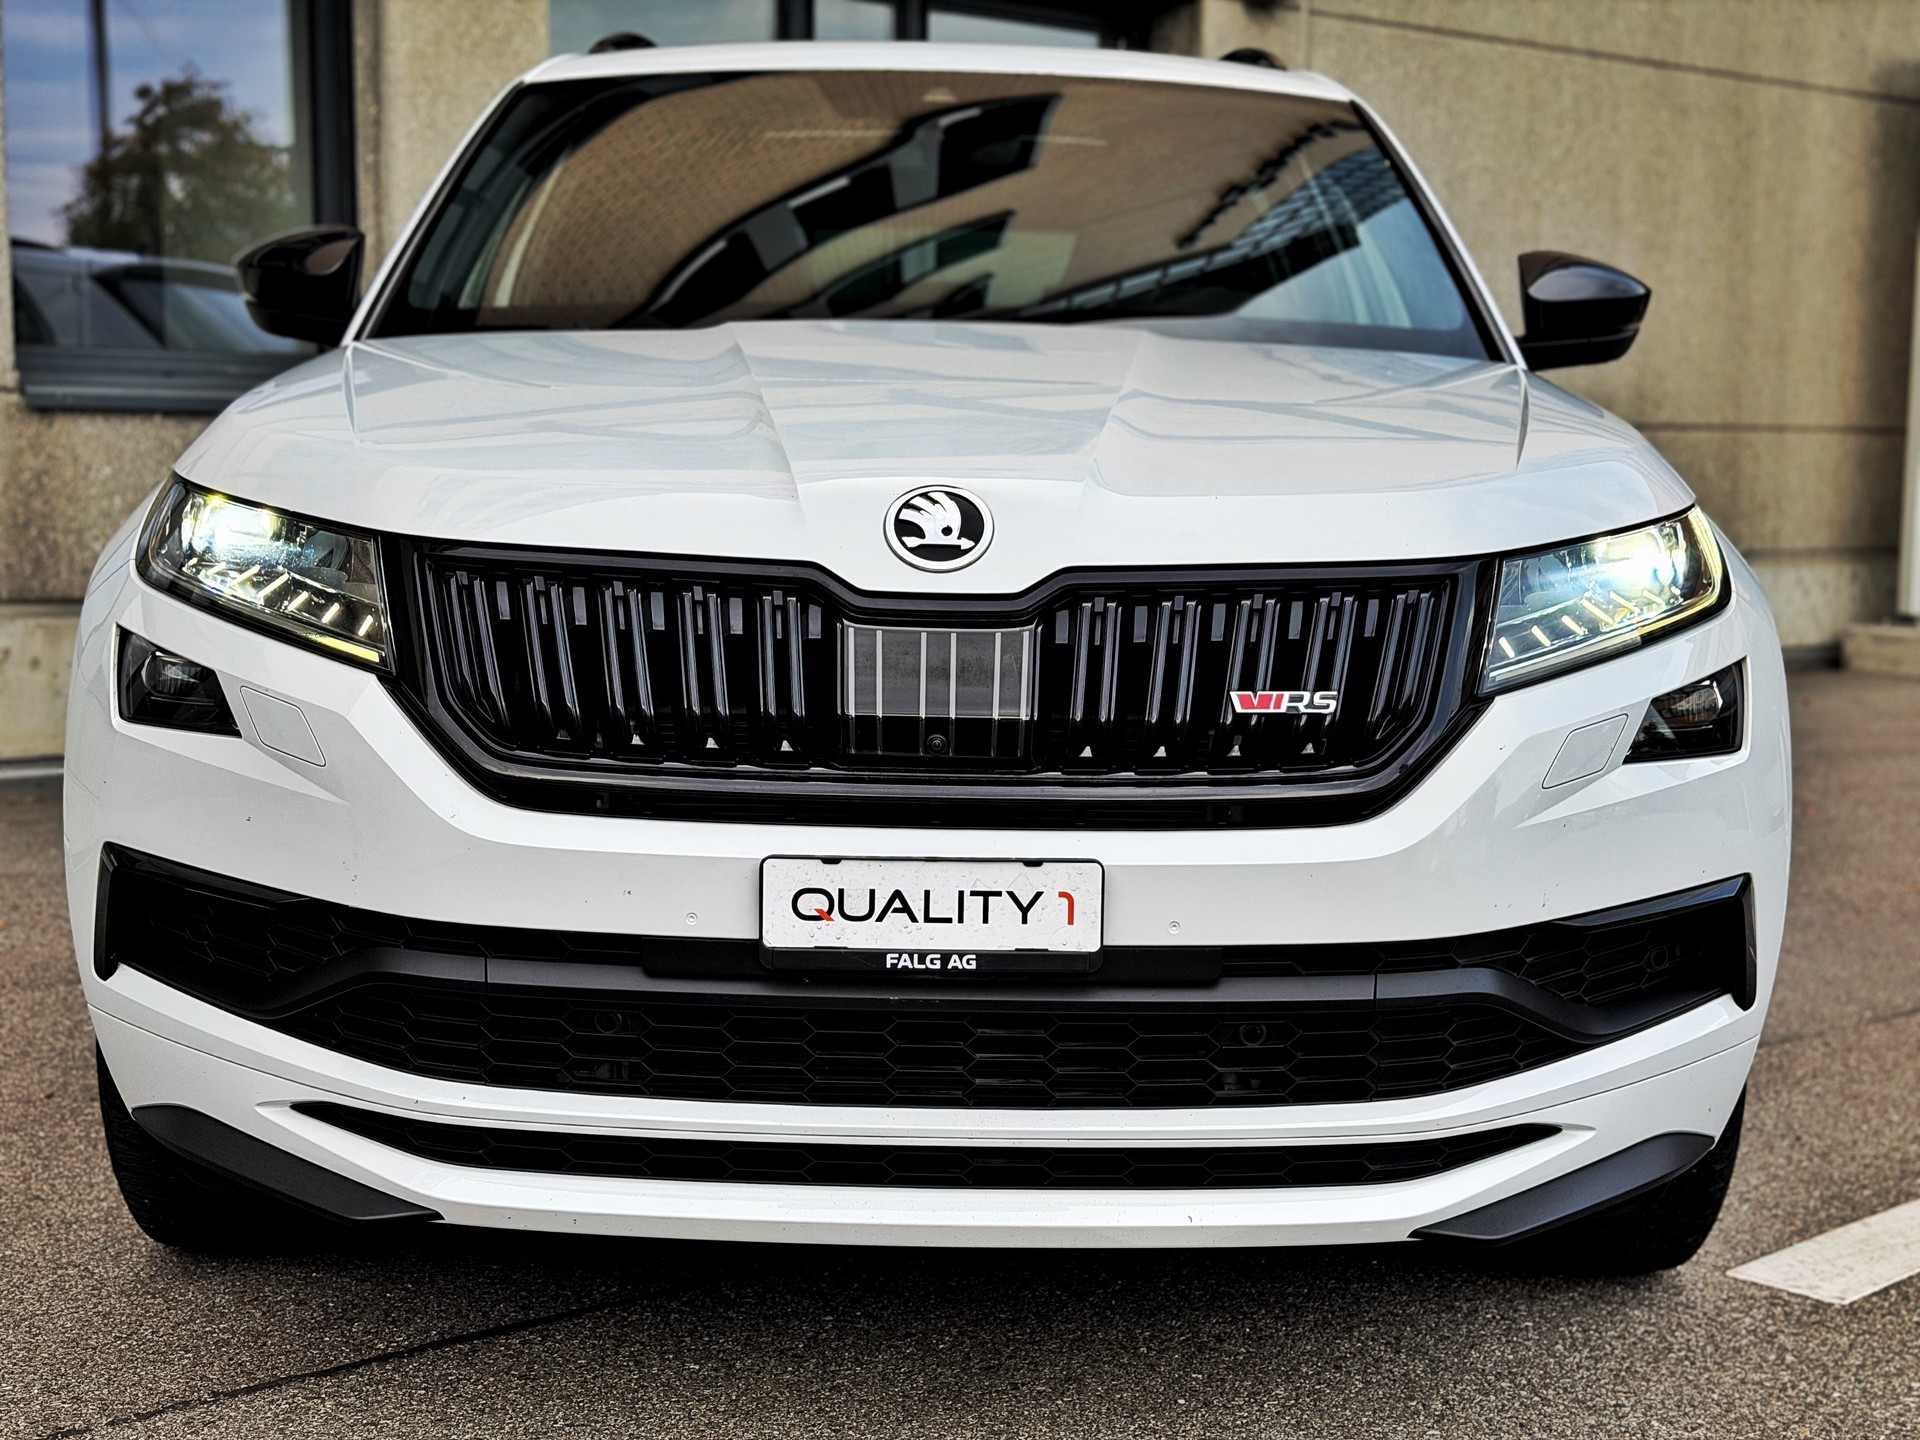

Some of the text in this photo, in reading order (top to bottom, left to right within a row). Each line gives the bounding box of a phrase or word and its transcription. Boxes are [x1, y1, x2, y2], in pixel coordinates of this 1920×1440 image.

[791, 887, 1045, 925] QUALITY
[886, 953, 977, 969] FALG AG
